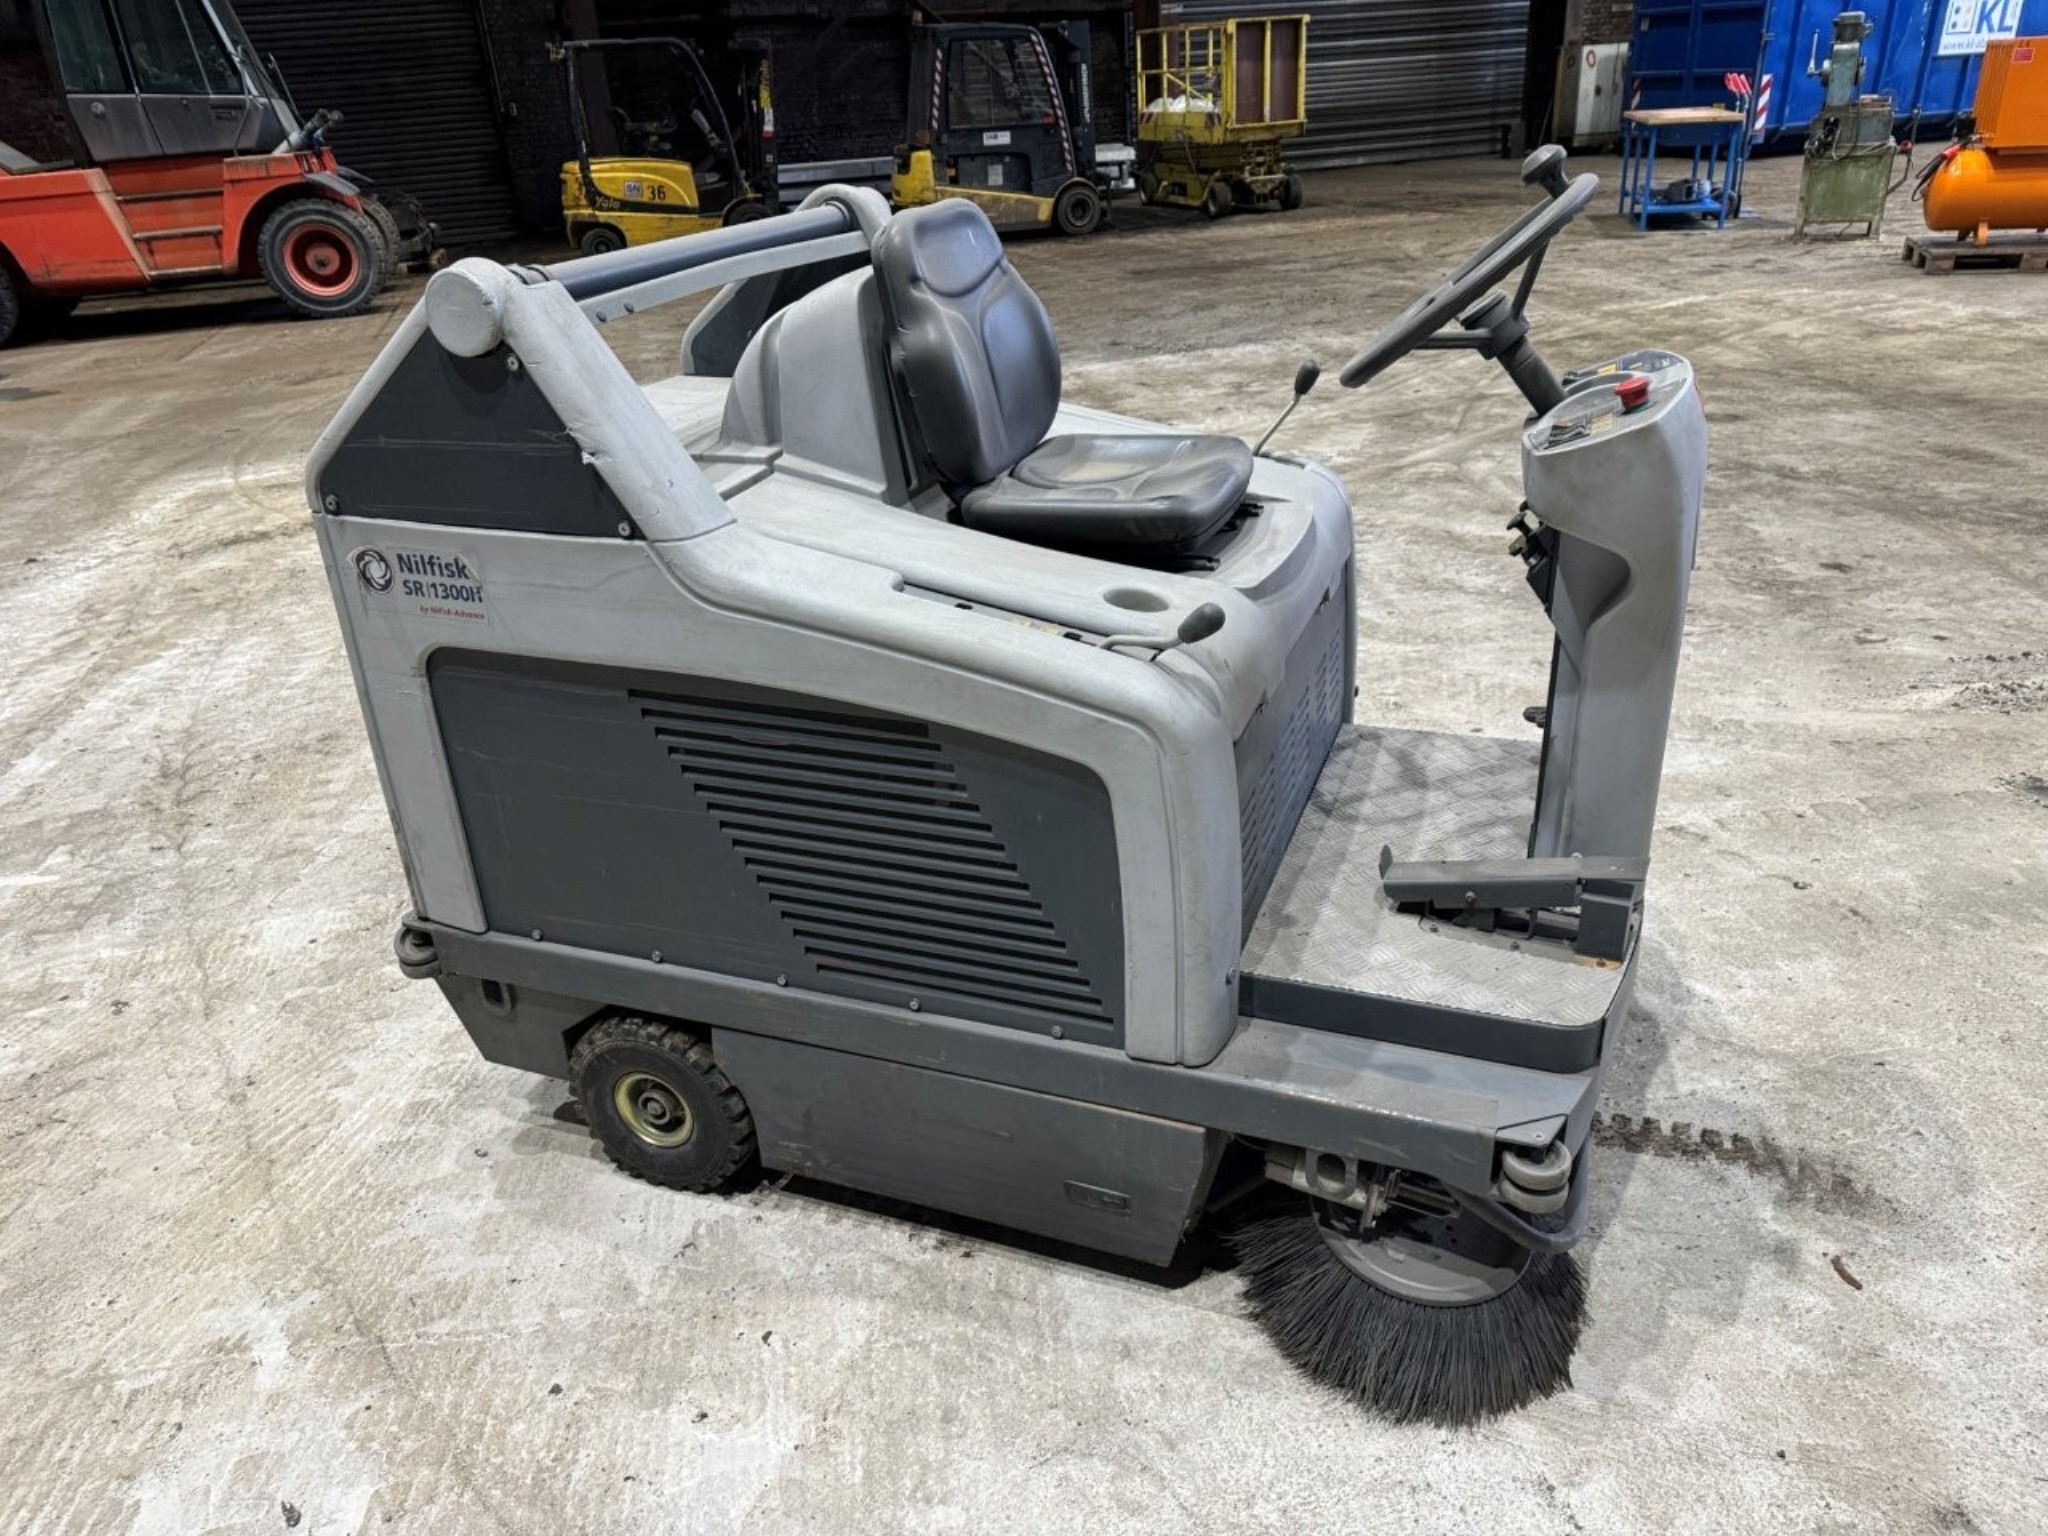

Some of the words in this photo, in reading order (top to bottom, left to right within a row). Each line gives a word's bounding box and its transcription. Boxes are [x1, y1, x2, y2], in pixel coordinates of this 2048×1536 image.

[1976, 0, 2013, 33] KL
[594, 196, 620, 210] Yale
[647, 185, 667, 201] 36
[396, 552, 471, 580] Nilfisk
